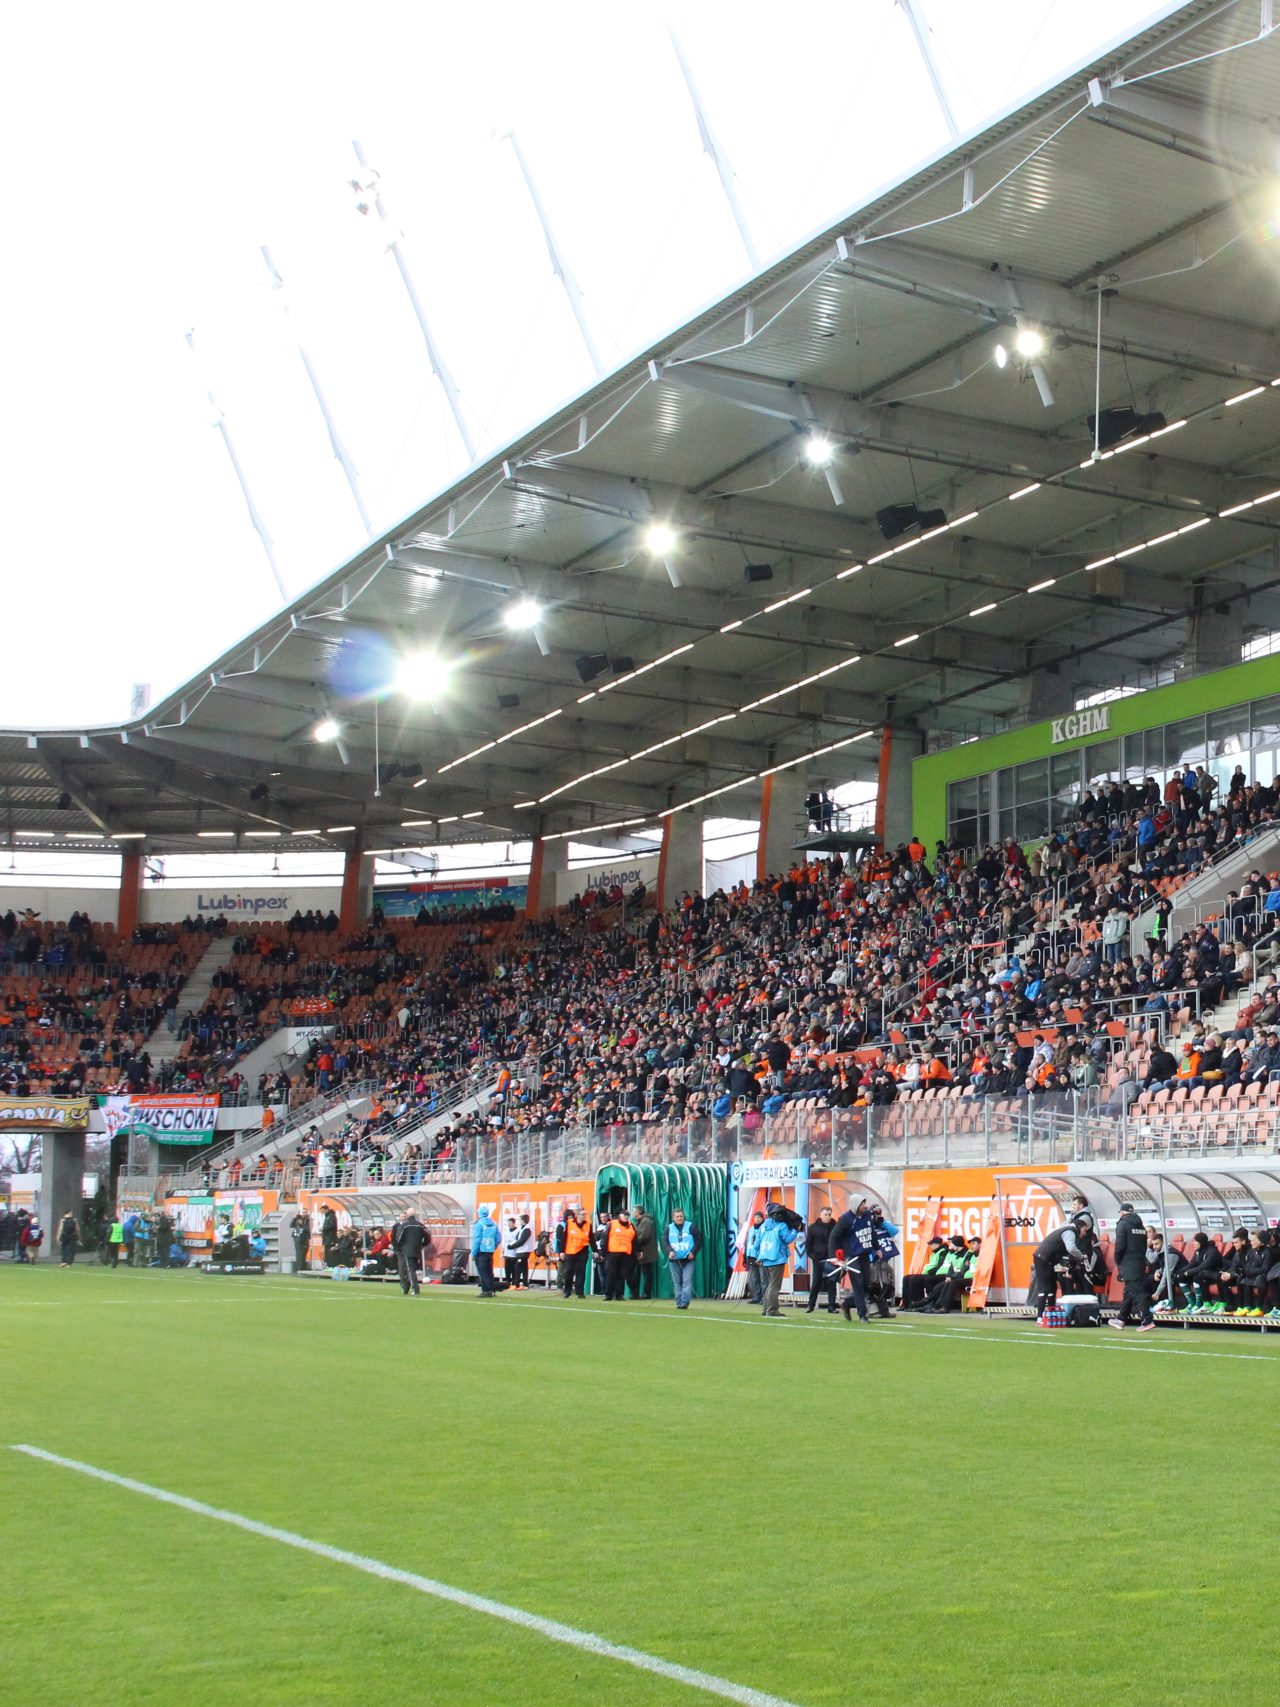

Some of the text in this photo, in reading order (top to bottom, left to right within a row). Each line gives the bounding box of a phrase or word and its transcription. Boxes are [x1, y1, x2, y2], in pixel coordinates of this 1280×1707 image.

[1052, 706, 1109, 744] KGHM
[197, 894, 289, 915] Lubinpex
[138, 1109, 215, 1129] WSCHOWA
[745, 1166, 799, 1179] EKSTRAKLASA
